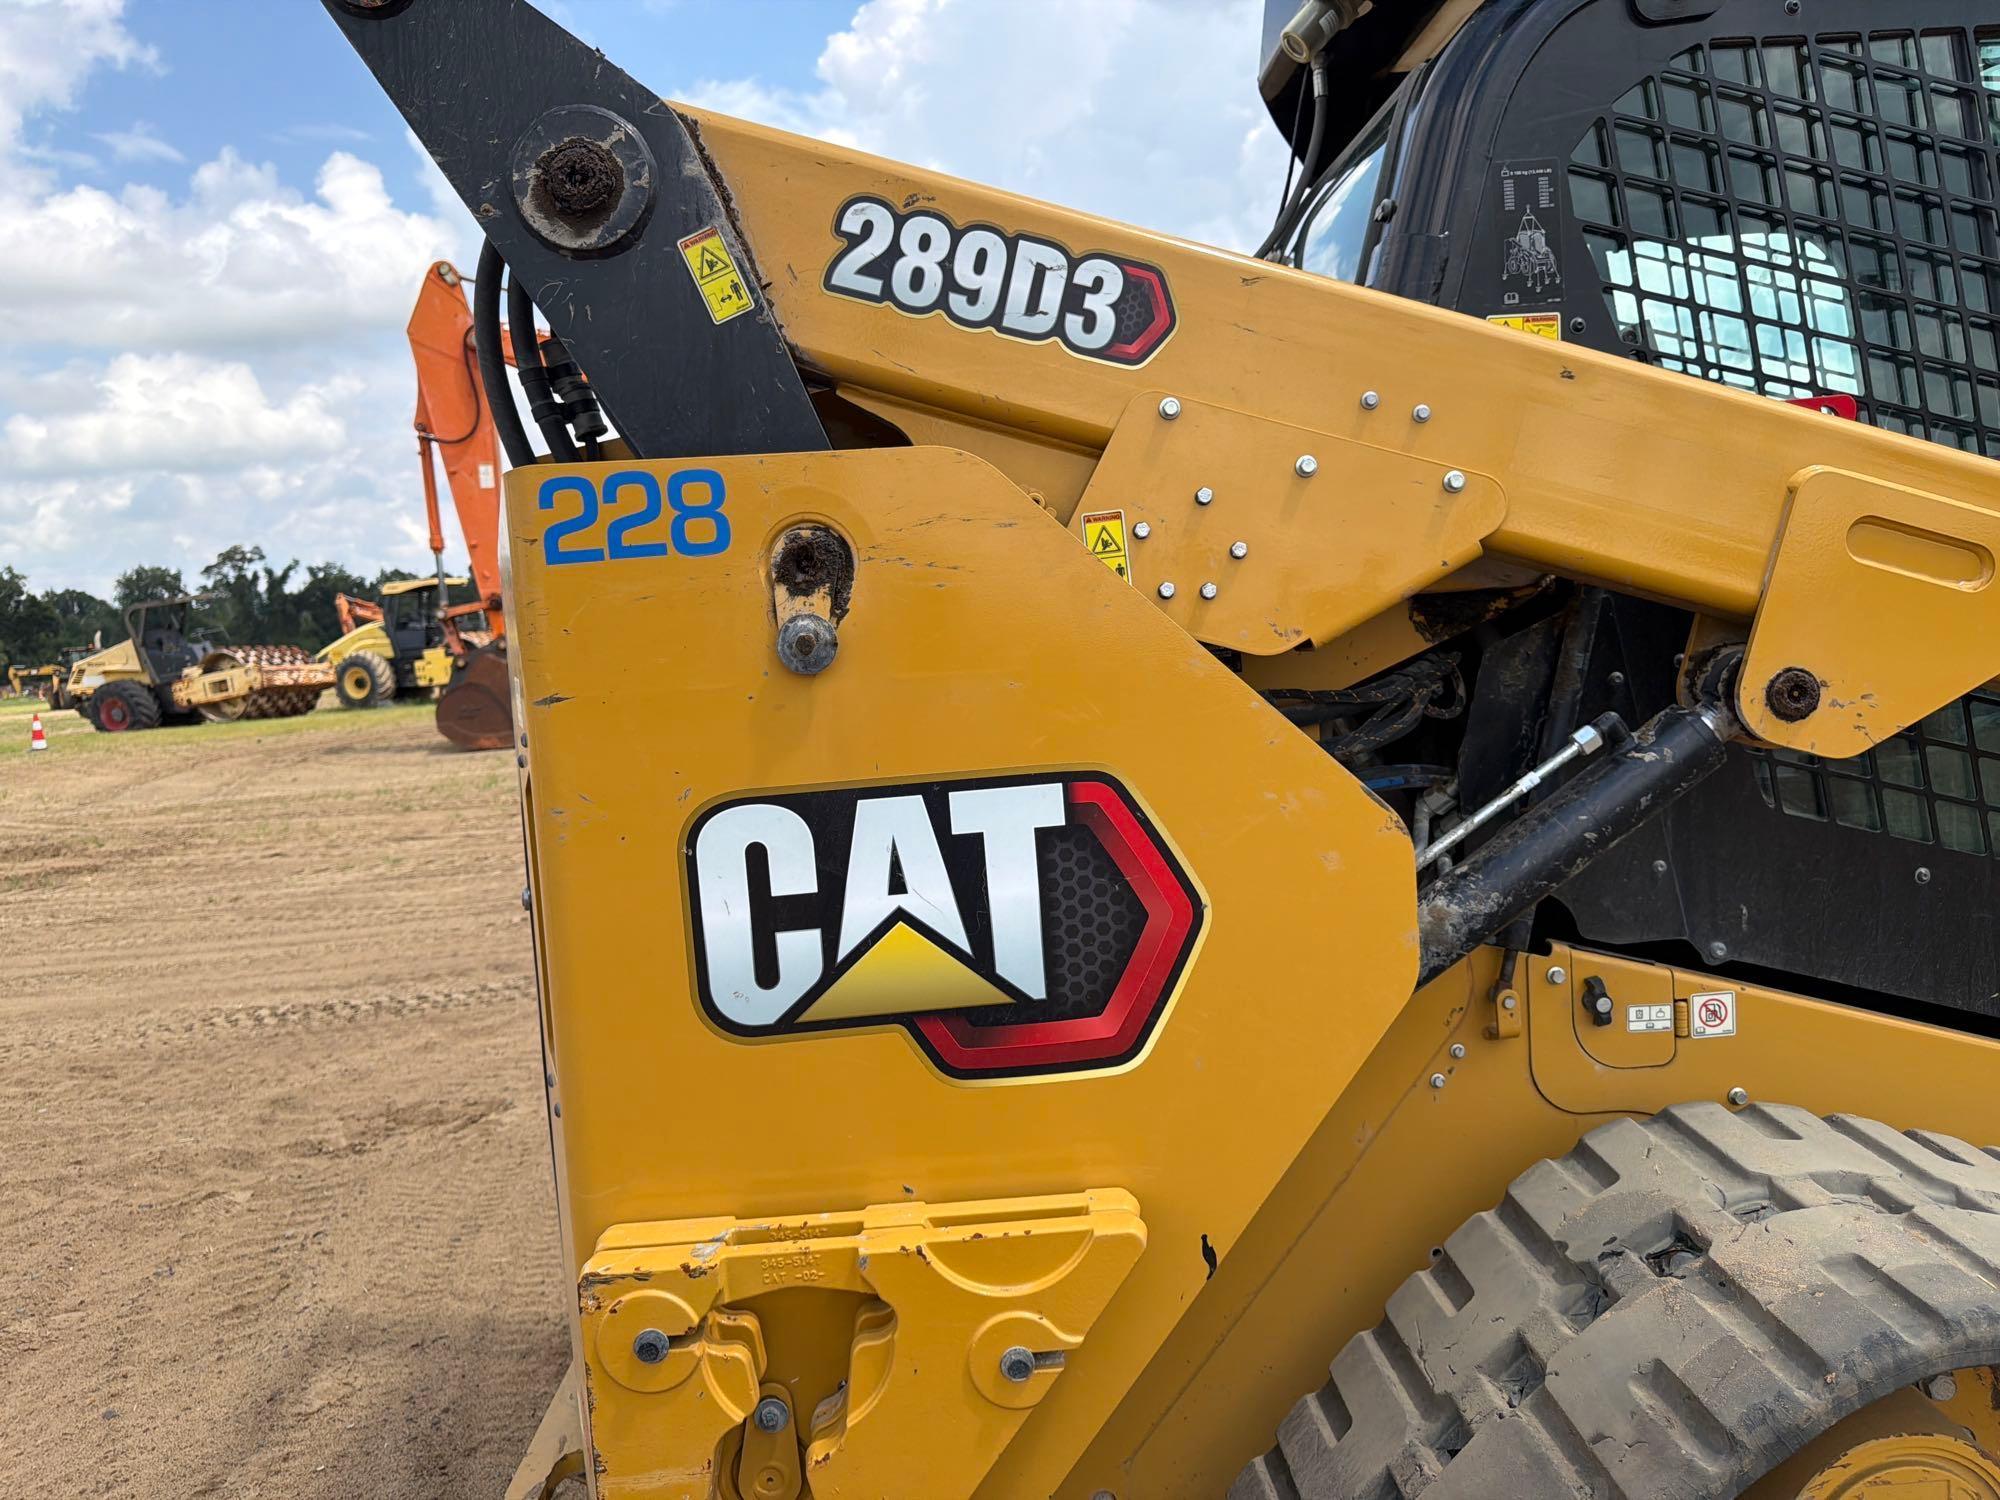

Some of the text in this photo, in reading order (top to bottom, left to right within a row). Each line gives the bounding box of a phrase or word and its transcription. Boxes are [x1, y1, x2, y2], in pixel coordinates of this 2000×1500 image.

[830, 202, 1124, 349] 289D3
[538, 469, 732, 565] 228
[1093, 514, 1120, 522] WARNING
[696, 783, 1066, 1026] CAT
